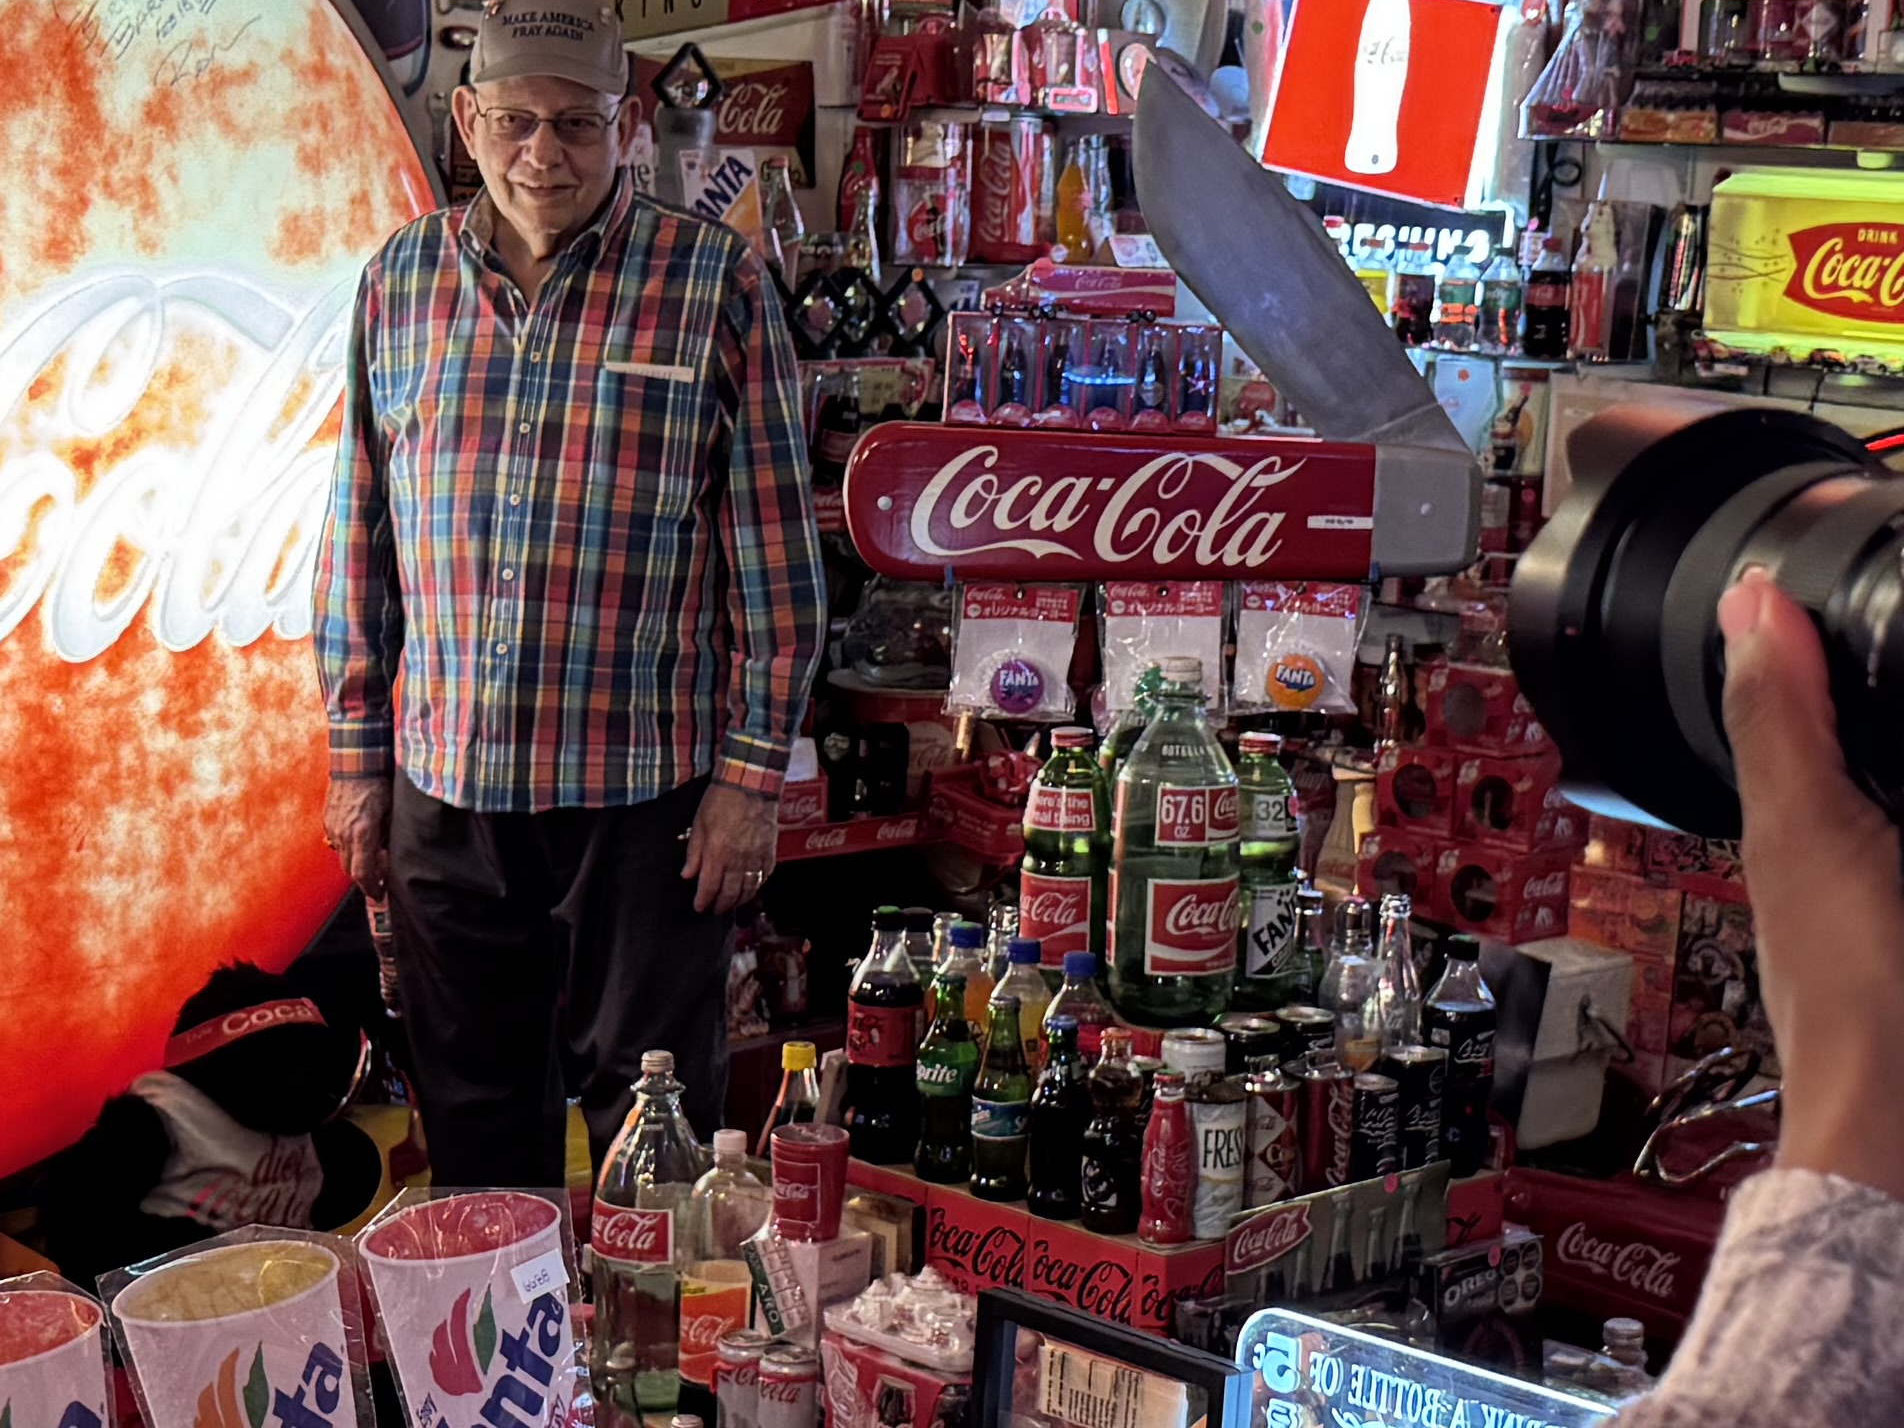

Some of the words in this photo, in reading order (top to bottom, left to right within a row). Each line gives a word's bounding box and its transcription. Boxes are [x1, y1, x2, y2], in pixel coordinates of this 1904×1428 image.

[503, 13, 538, 28] MAKE
[539, 10, 594, 33] AMERICA
[1858, 229, 1897, 244] DRINK
[909, 445, 1307, 567] Coca-Cola
[999, 669, 1040, 688] FANTA
[1275, 666, 1316, 685] FANTA
[1160, 795, 1204, 823] 67.6
[1255, 800, 1283, 821] 32
